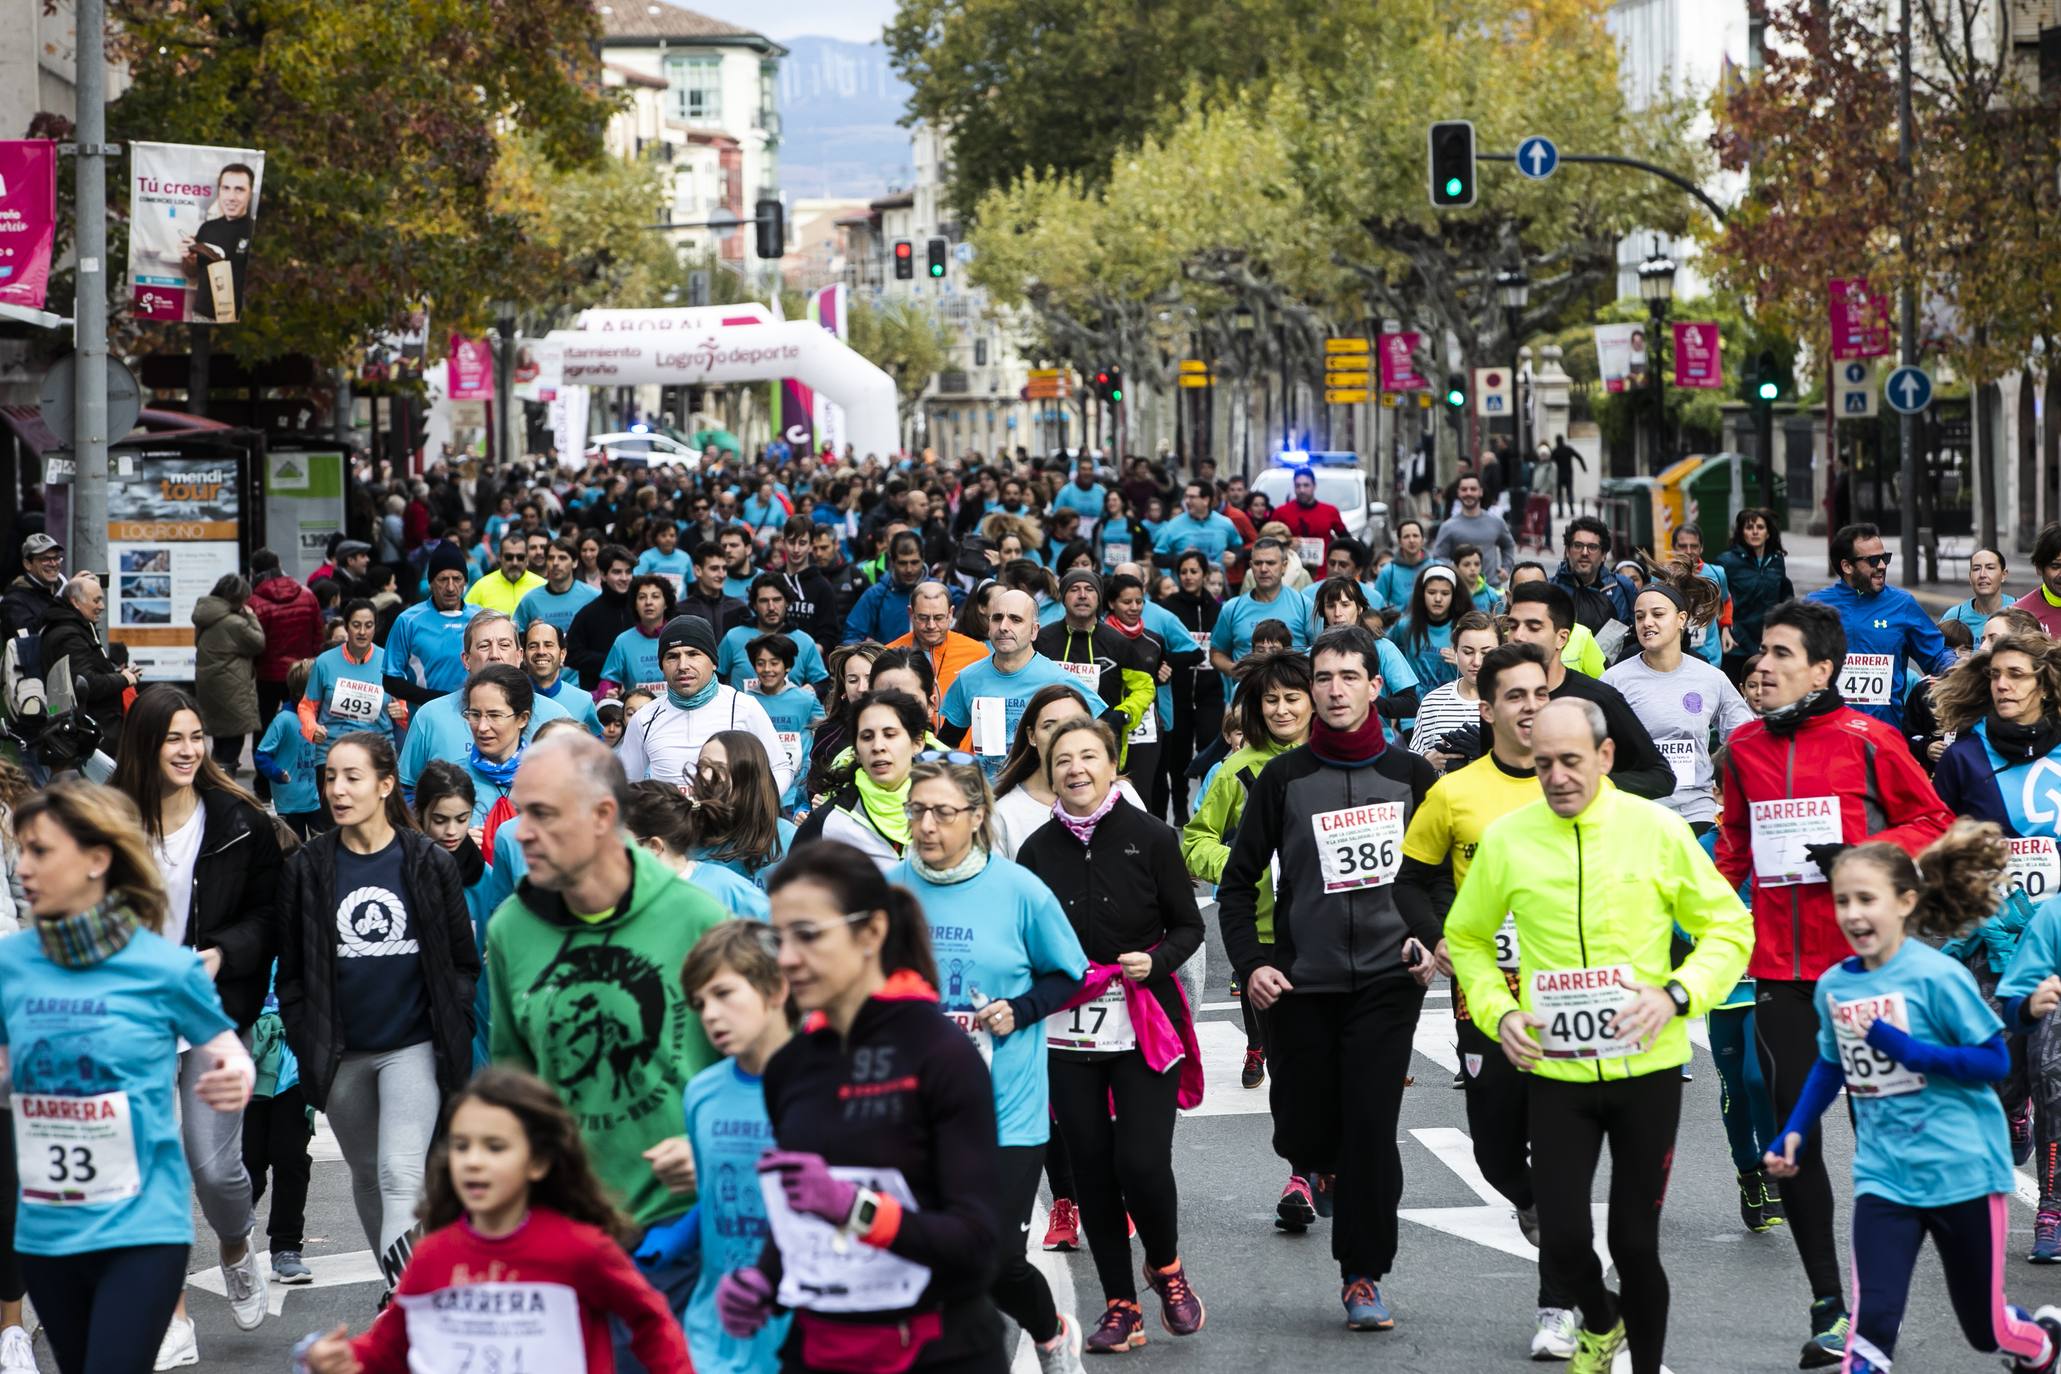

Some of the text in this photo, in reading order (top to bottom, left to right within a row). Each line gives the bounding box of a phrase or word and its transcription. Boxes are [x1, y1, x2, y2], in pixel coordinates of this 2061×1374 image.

[138, 176, 212, 197] Tú creas
[169, 469, 222, 483] mendi
[161, 479, 222, 501] tour
[1844, 655, 1889, 666] ARRERA
[340, 680, 380, 694] CARRERA
[1845, 676, 1879, 694] 470
[340, 697, 372, 715] 493
[1321, 804, 1397, 832] CARRERA
[1755, 800, 1831, 822] CARRERA
[1337, 839, 1394, 875] 386
[1537, 968, 1621, 991] CARRERA
[26, 998, 107, 1016] CARRERA
[1069, 1006, 1107, 1034] 17
[1551, 1008, 1620, 1042] 408
[22, 1097, 116, 1120] CARRERA
[48, 1145, 97, 1182] 33
[431, 1290, 545, 1313] CARRERA
